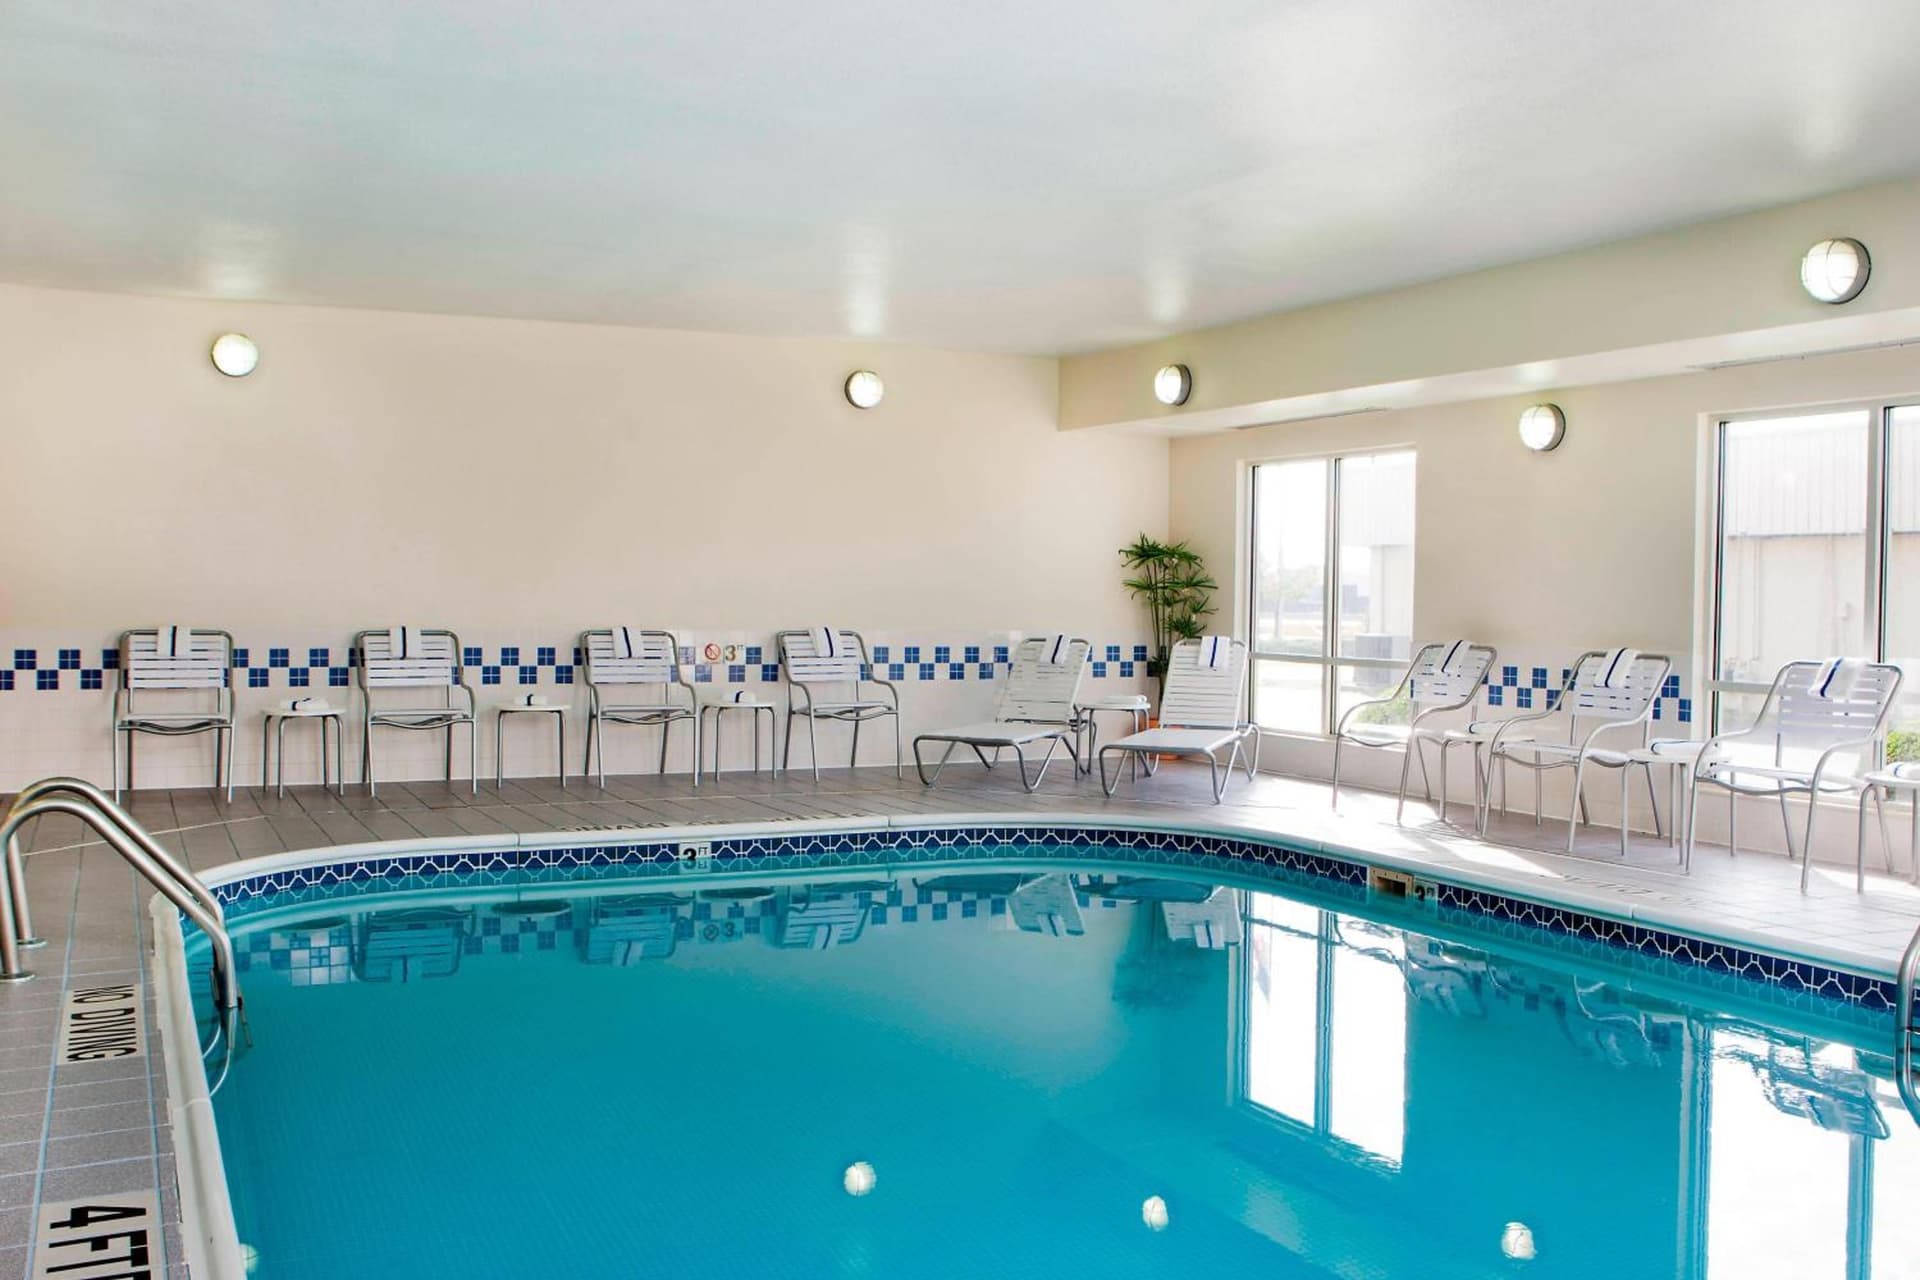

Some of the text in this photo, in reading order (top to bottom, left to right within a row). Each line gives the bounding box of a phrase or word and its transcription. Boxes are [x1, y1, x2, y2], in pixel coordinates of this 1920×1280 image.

[725, 645, 736, 661] 3
[66, 984, 137, 1062] NO DIVING
